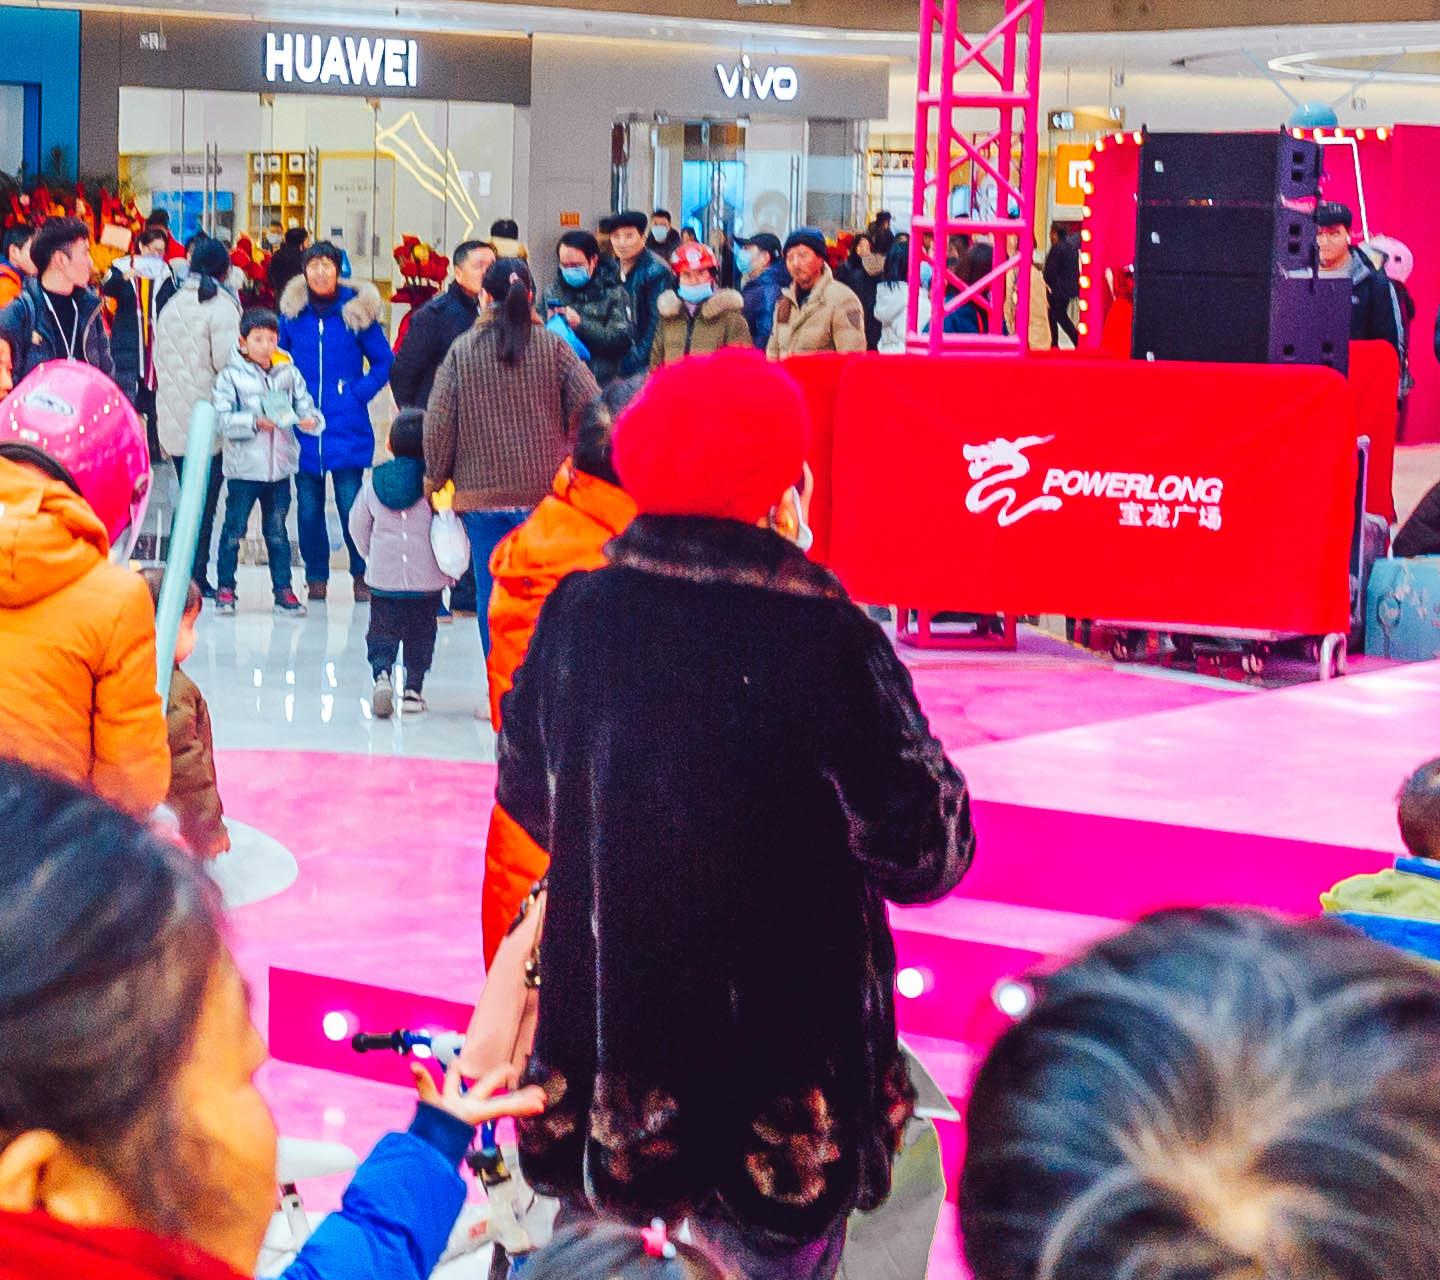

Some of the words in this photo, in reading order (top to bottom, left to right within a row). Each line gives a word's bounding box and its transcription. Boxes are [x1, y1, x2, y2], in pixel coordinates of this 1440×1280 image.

[265, 32, 418, 87] HUAWEI
[716, 54, 798, 101] vivo
[1042, 468, 1223, 504] POWERLONG
[1119, 501, 1222, 531] 宝龙广场
